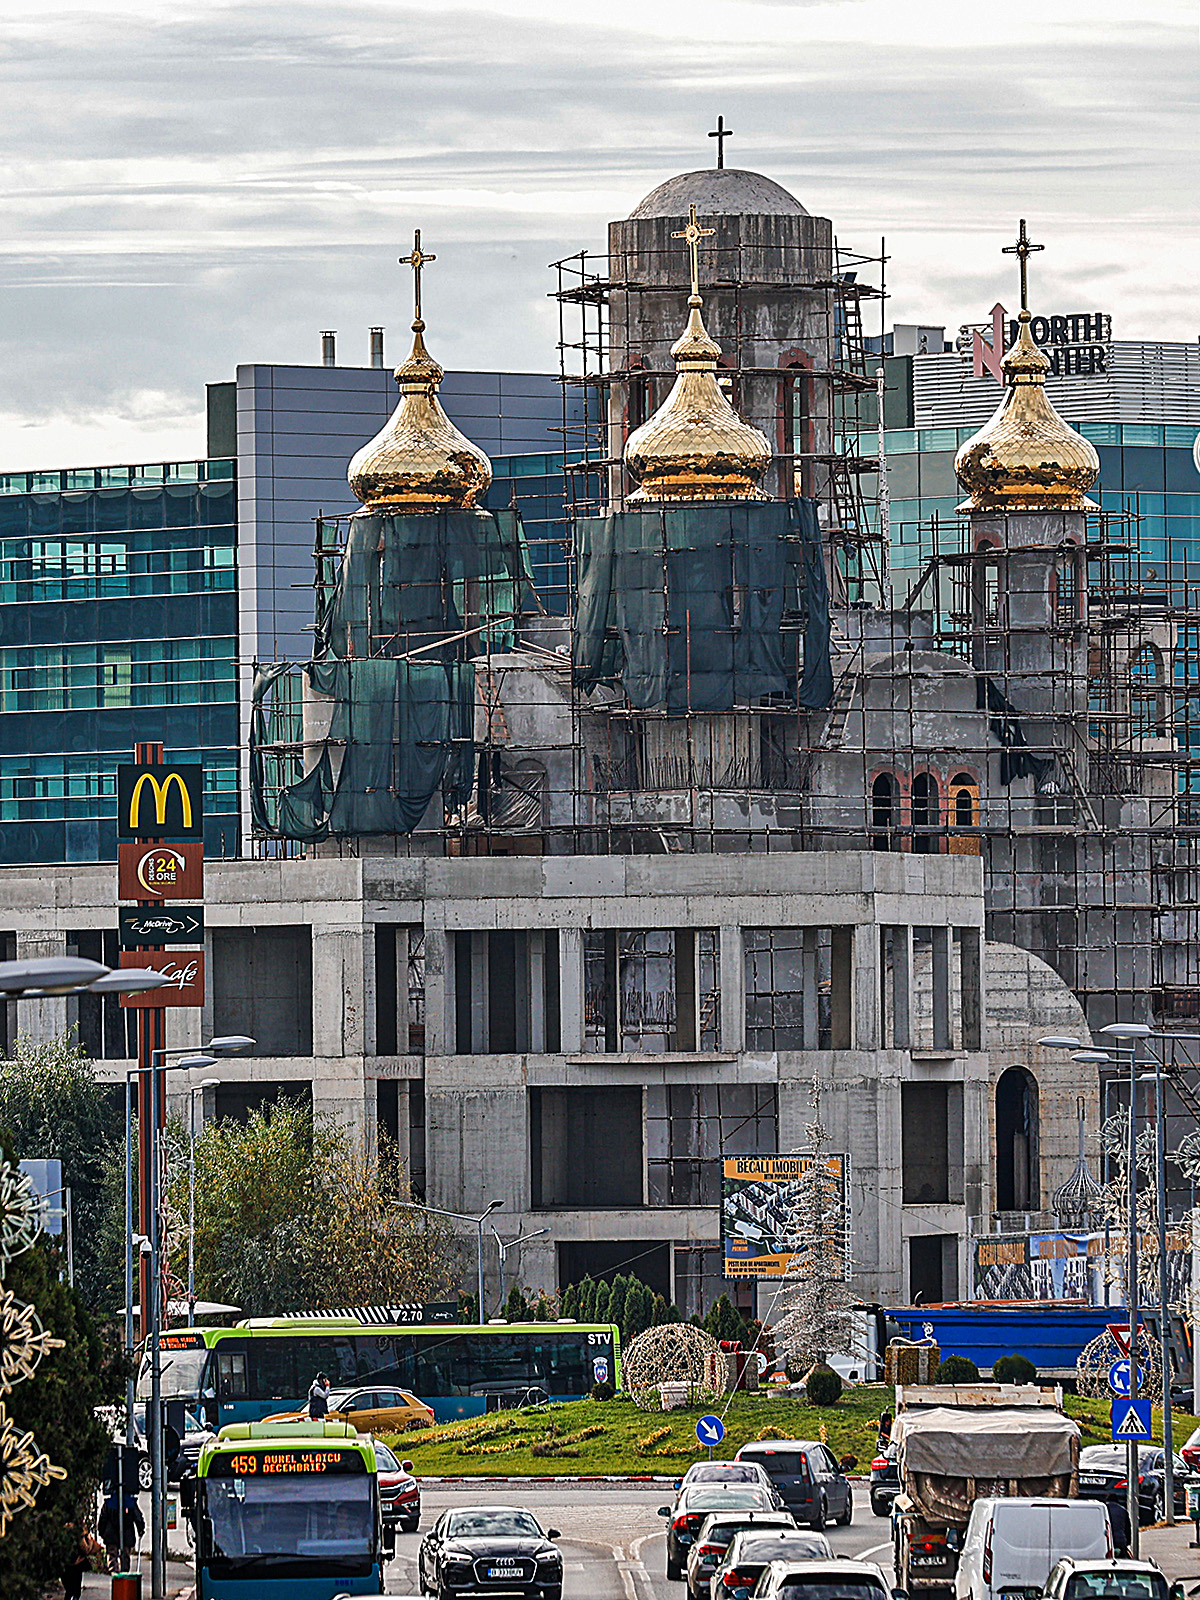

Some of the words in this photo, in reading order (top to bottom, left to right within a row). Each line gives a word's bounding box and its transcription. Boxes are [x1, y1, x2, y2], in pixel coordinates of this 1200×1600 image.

[1041, 346, 1107, 376] NTER
[156, 857, 177, 872] 24
[156, 872, 177, 881] ORE
[143, 919, 173, 928] McDrive
[737, 1160, 770, 1173] BECALI
[401, 1310, 423, 1322] 2.70
[587, 1333, 611, 1345] STV
[230, 1455, 257, 1474] 459
[264, 1454, 297, 1464] AUREL
[301, 1453, 341, 1463] VLAICU
